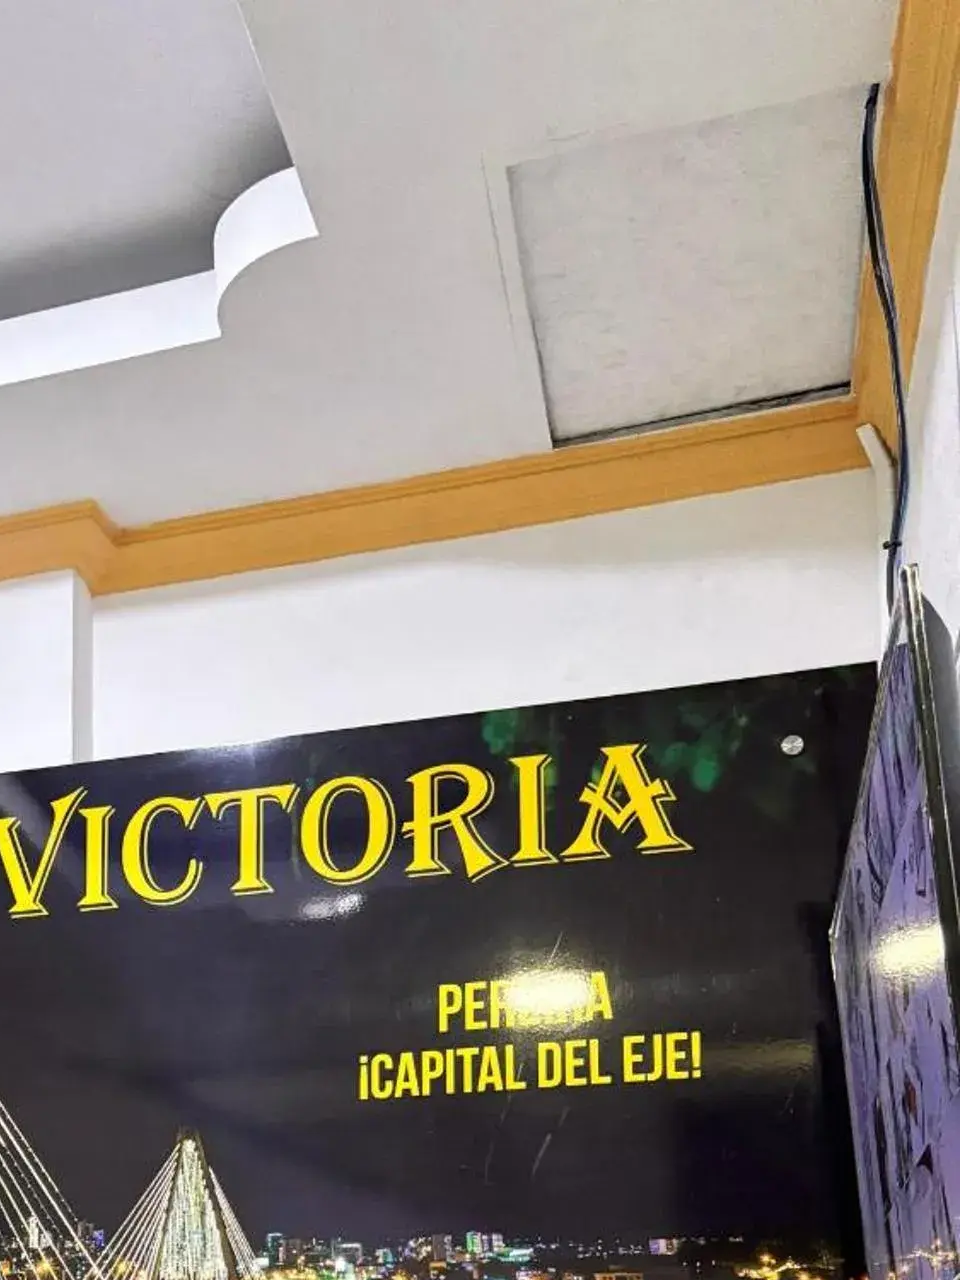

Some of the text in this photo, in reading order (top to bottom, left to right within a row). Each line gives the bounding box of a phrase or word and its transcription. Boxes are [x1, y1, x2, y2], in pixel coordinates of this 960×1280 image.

[438, 971, 614, 1033] PERA
[358, 1031, 702, 1101] ¡CAPITAL DEL EJE!
